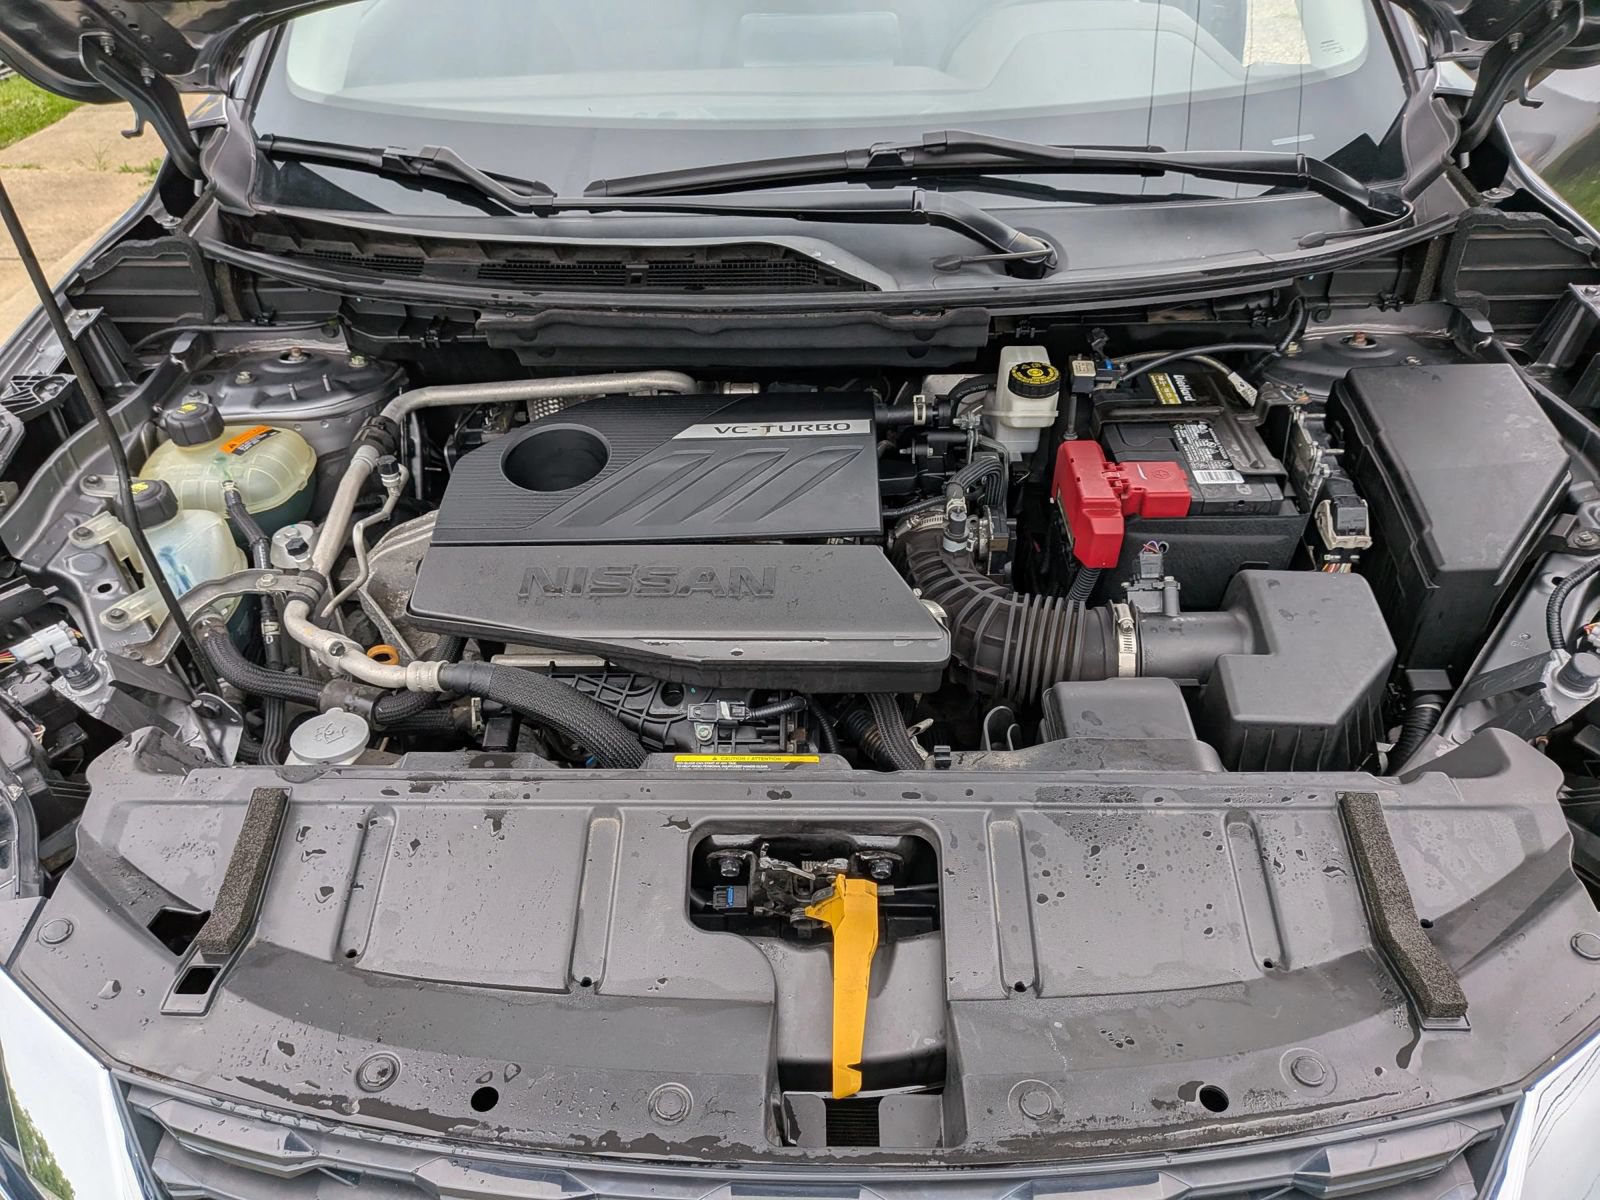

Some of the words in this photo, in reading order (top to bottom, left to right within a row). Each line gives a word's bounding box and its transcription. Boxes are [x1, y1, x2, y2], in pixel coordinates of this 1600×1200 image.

[1173, 374, 1197, 402] DieHard
[714, 422, 851, 434] VC-TURBO
[518, 566, 777, 599] NISSAN
